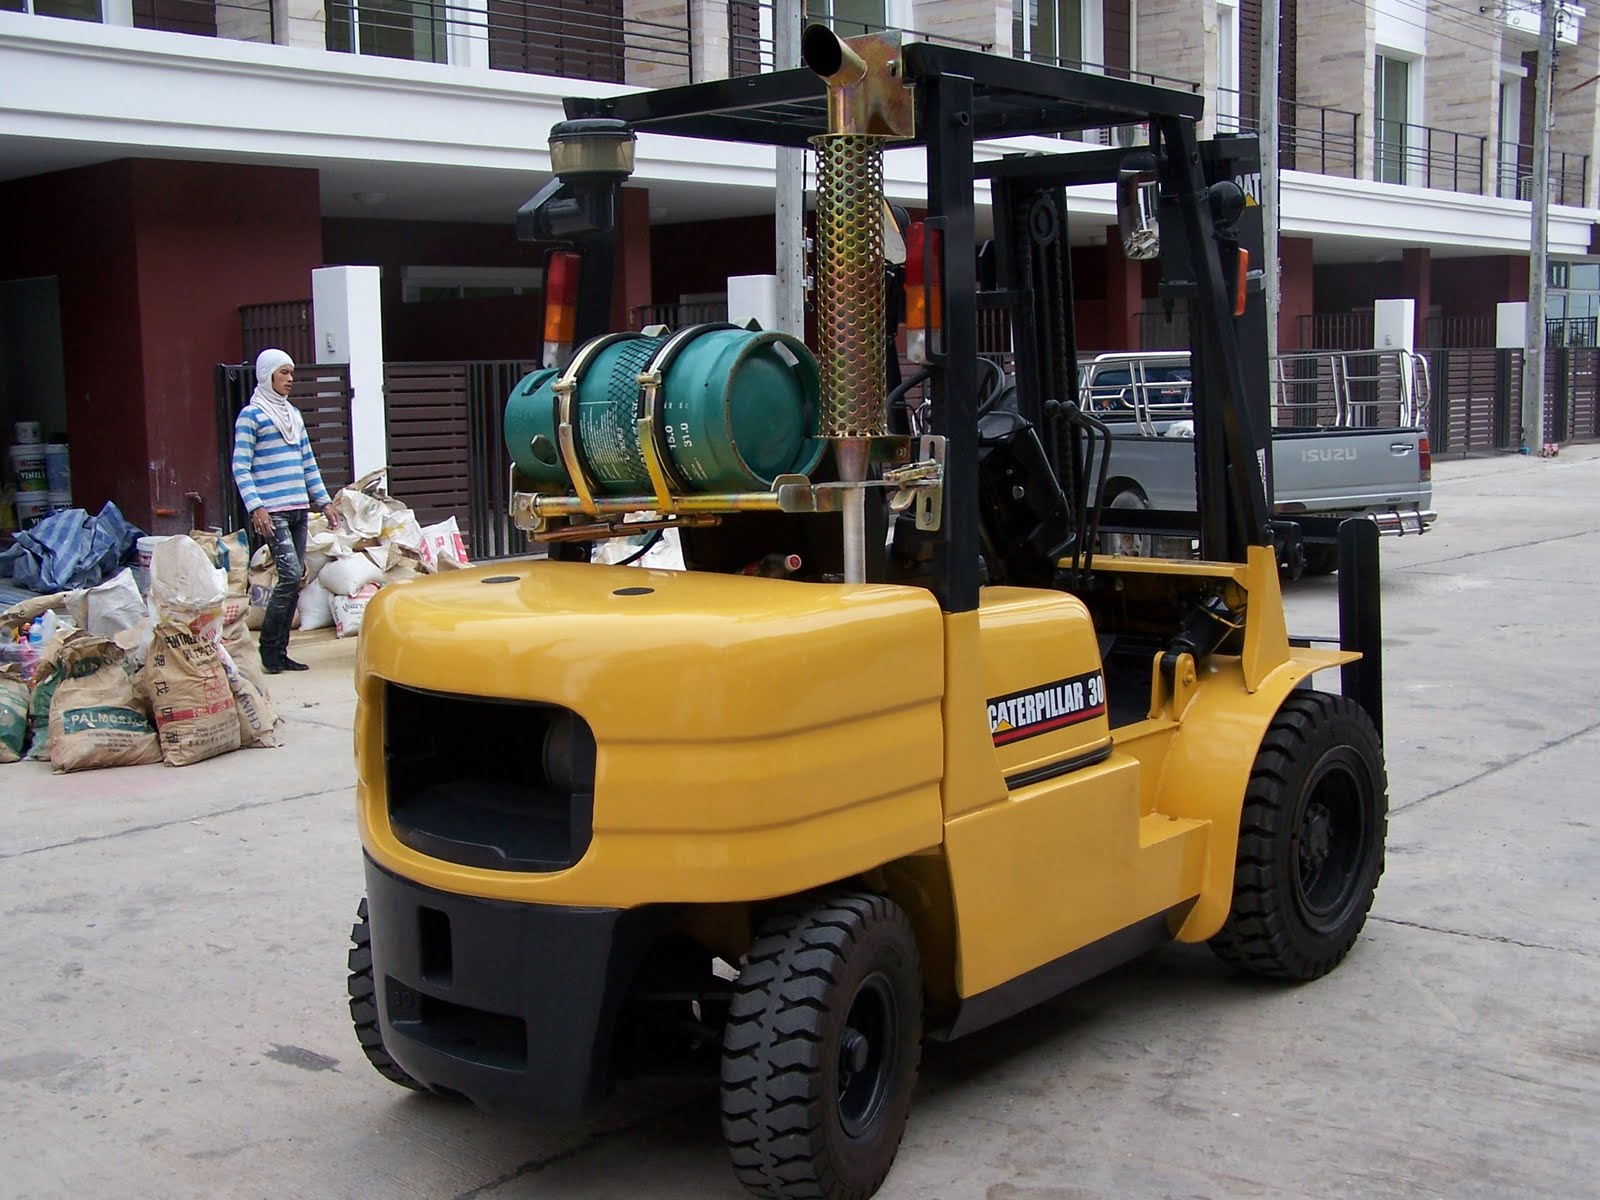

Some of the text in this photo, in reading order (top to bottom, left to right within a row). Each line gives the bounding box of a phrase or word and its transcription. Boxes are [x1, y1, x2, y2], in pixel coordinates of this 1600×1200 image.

[664, 425, 677, 450] 15.0
[680, 422, 693, 447] 31.0
[1301, 447, 1358, 462] ISUZU
[987, 675, 1105, 733] CATERPILLAR 30
